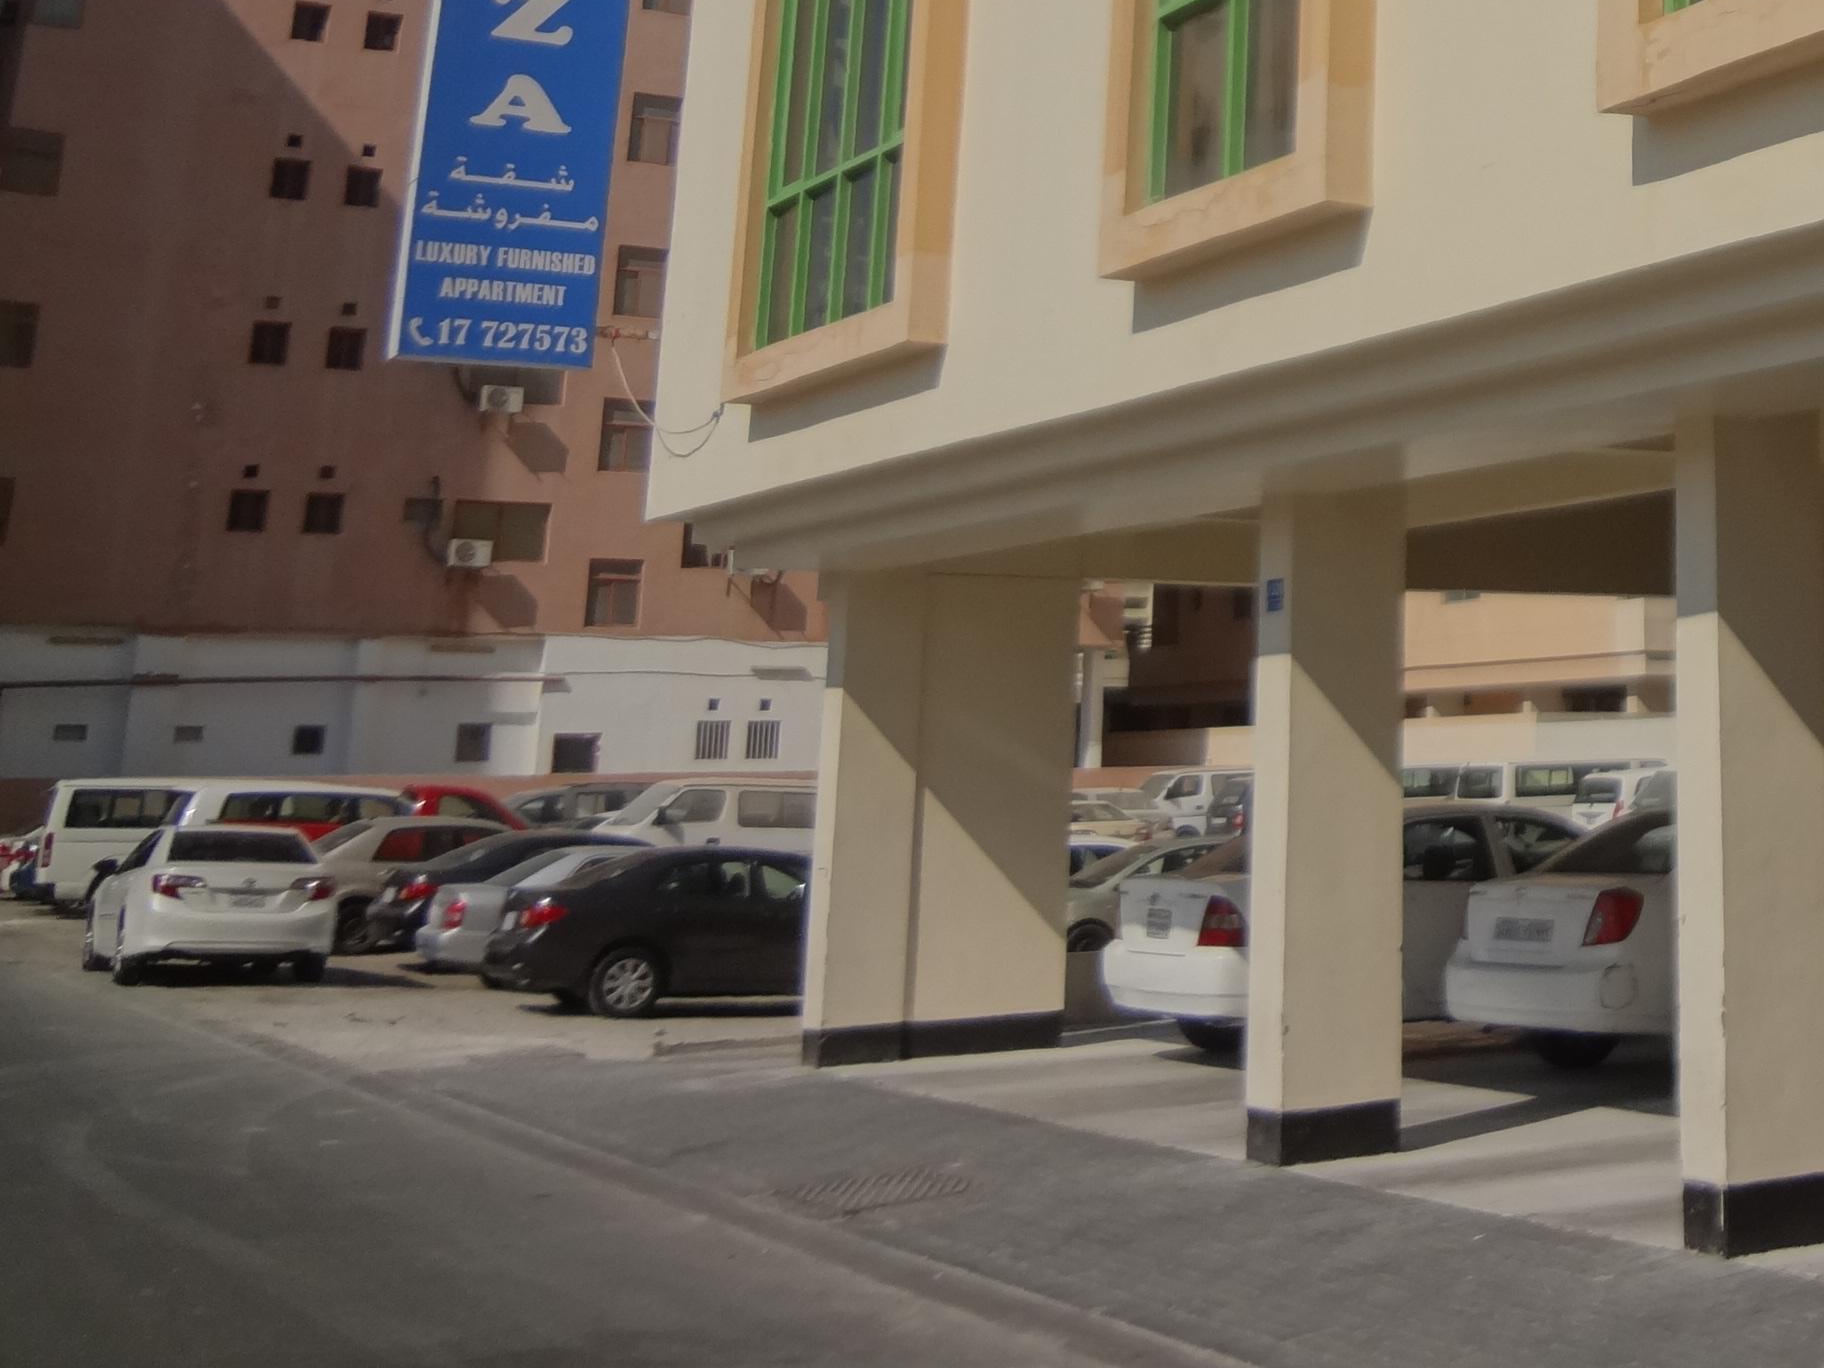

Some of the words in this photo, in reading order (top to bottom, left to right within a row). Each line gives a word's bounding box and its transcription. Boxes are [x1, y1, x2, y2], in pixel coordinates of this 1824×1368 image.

[450, 156, 574, 192] شقة
[420, 190, 599, 231] مفروشة
[416, 240, 492, 266] LUXURY
[497, 247, 596, 275] FURNISHED
[438, 277, 567, 306] APPARTMENT
[438, 318, 472, 345] 17
[481, 321, 588, 353] 727573
